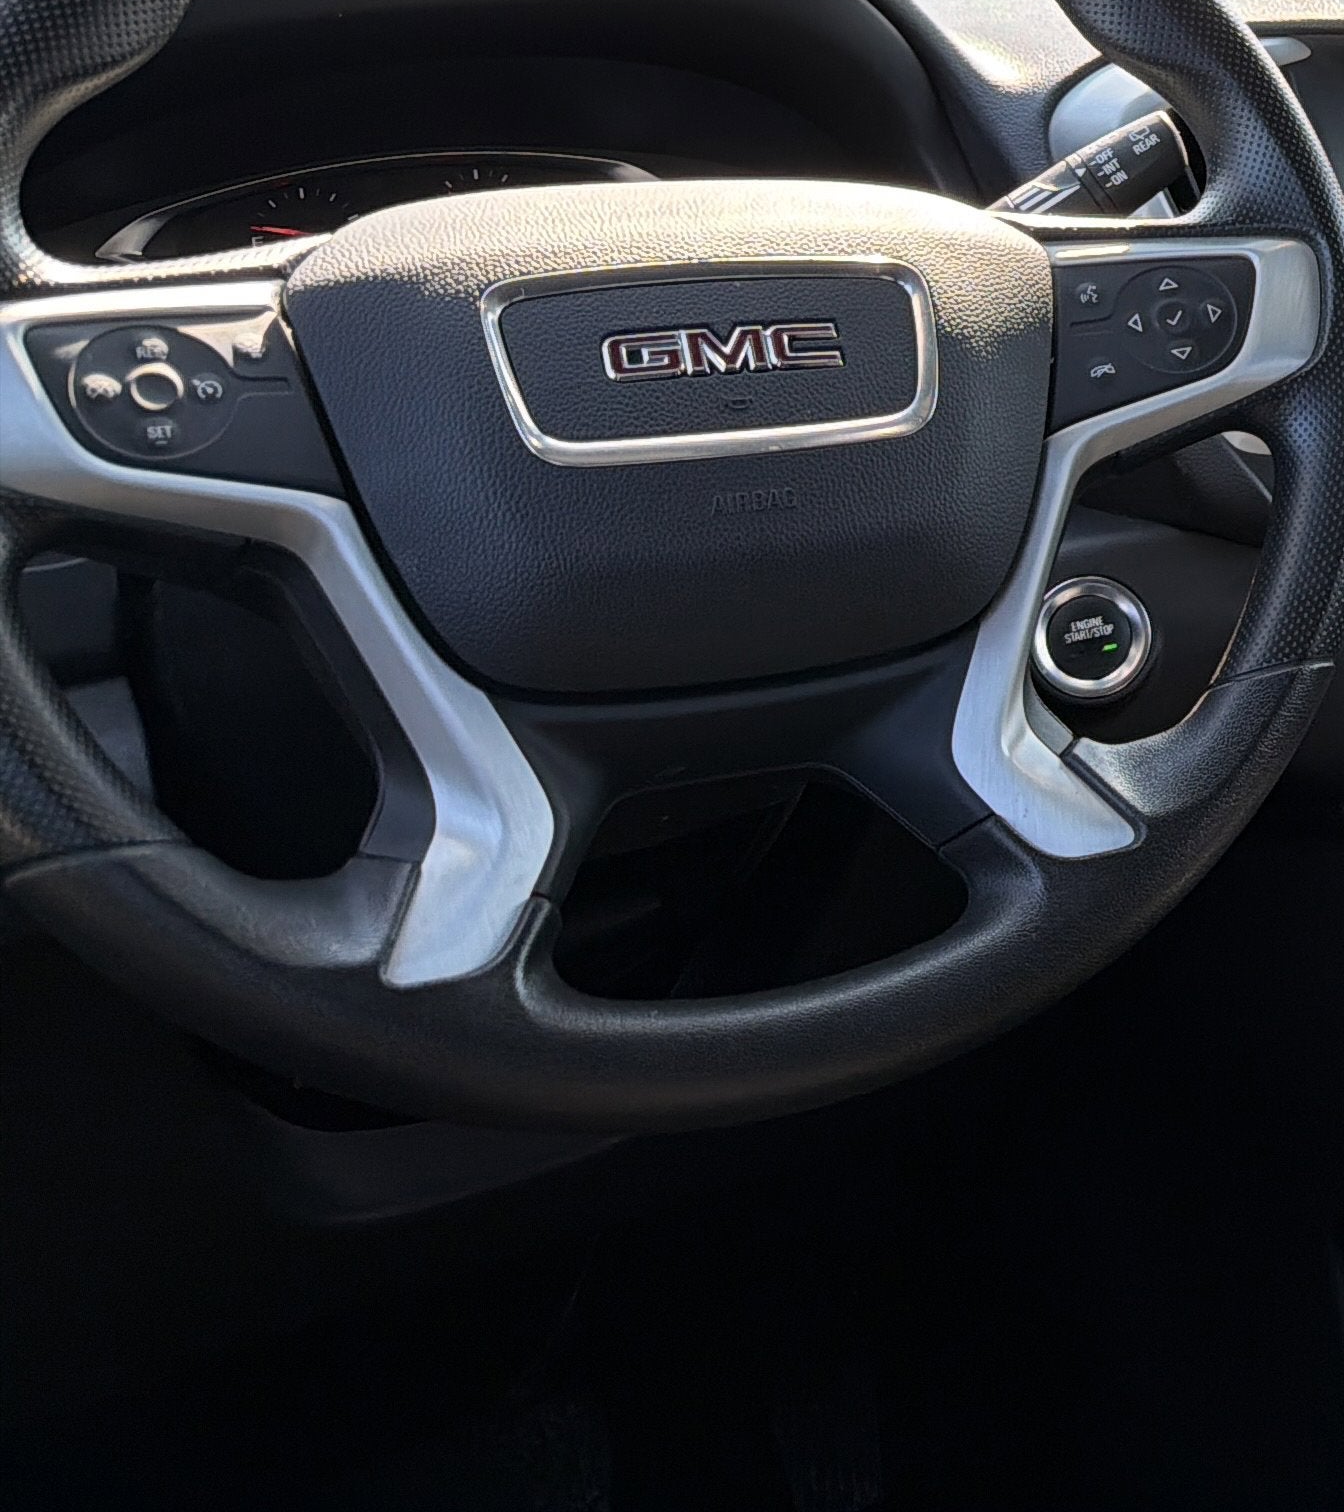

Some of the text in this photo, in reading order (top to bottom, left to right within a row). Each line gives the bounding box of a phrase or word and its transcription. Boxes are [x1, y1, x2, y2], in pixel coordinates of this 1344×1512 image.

[1133, 133, 1161, 156] REAR
[600, 321, 847, 384] GMC
[146, 425, 172, 439] SET
[711, 488, 799, 517] AIRBAG
[1063, 624, 1116, 645] START/STOP
[1070, 615, 1105, 633] ENGINE
